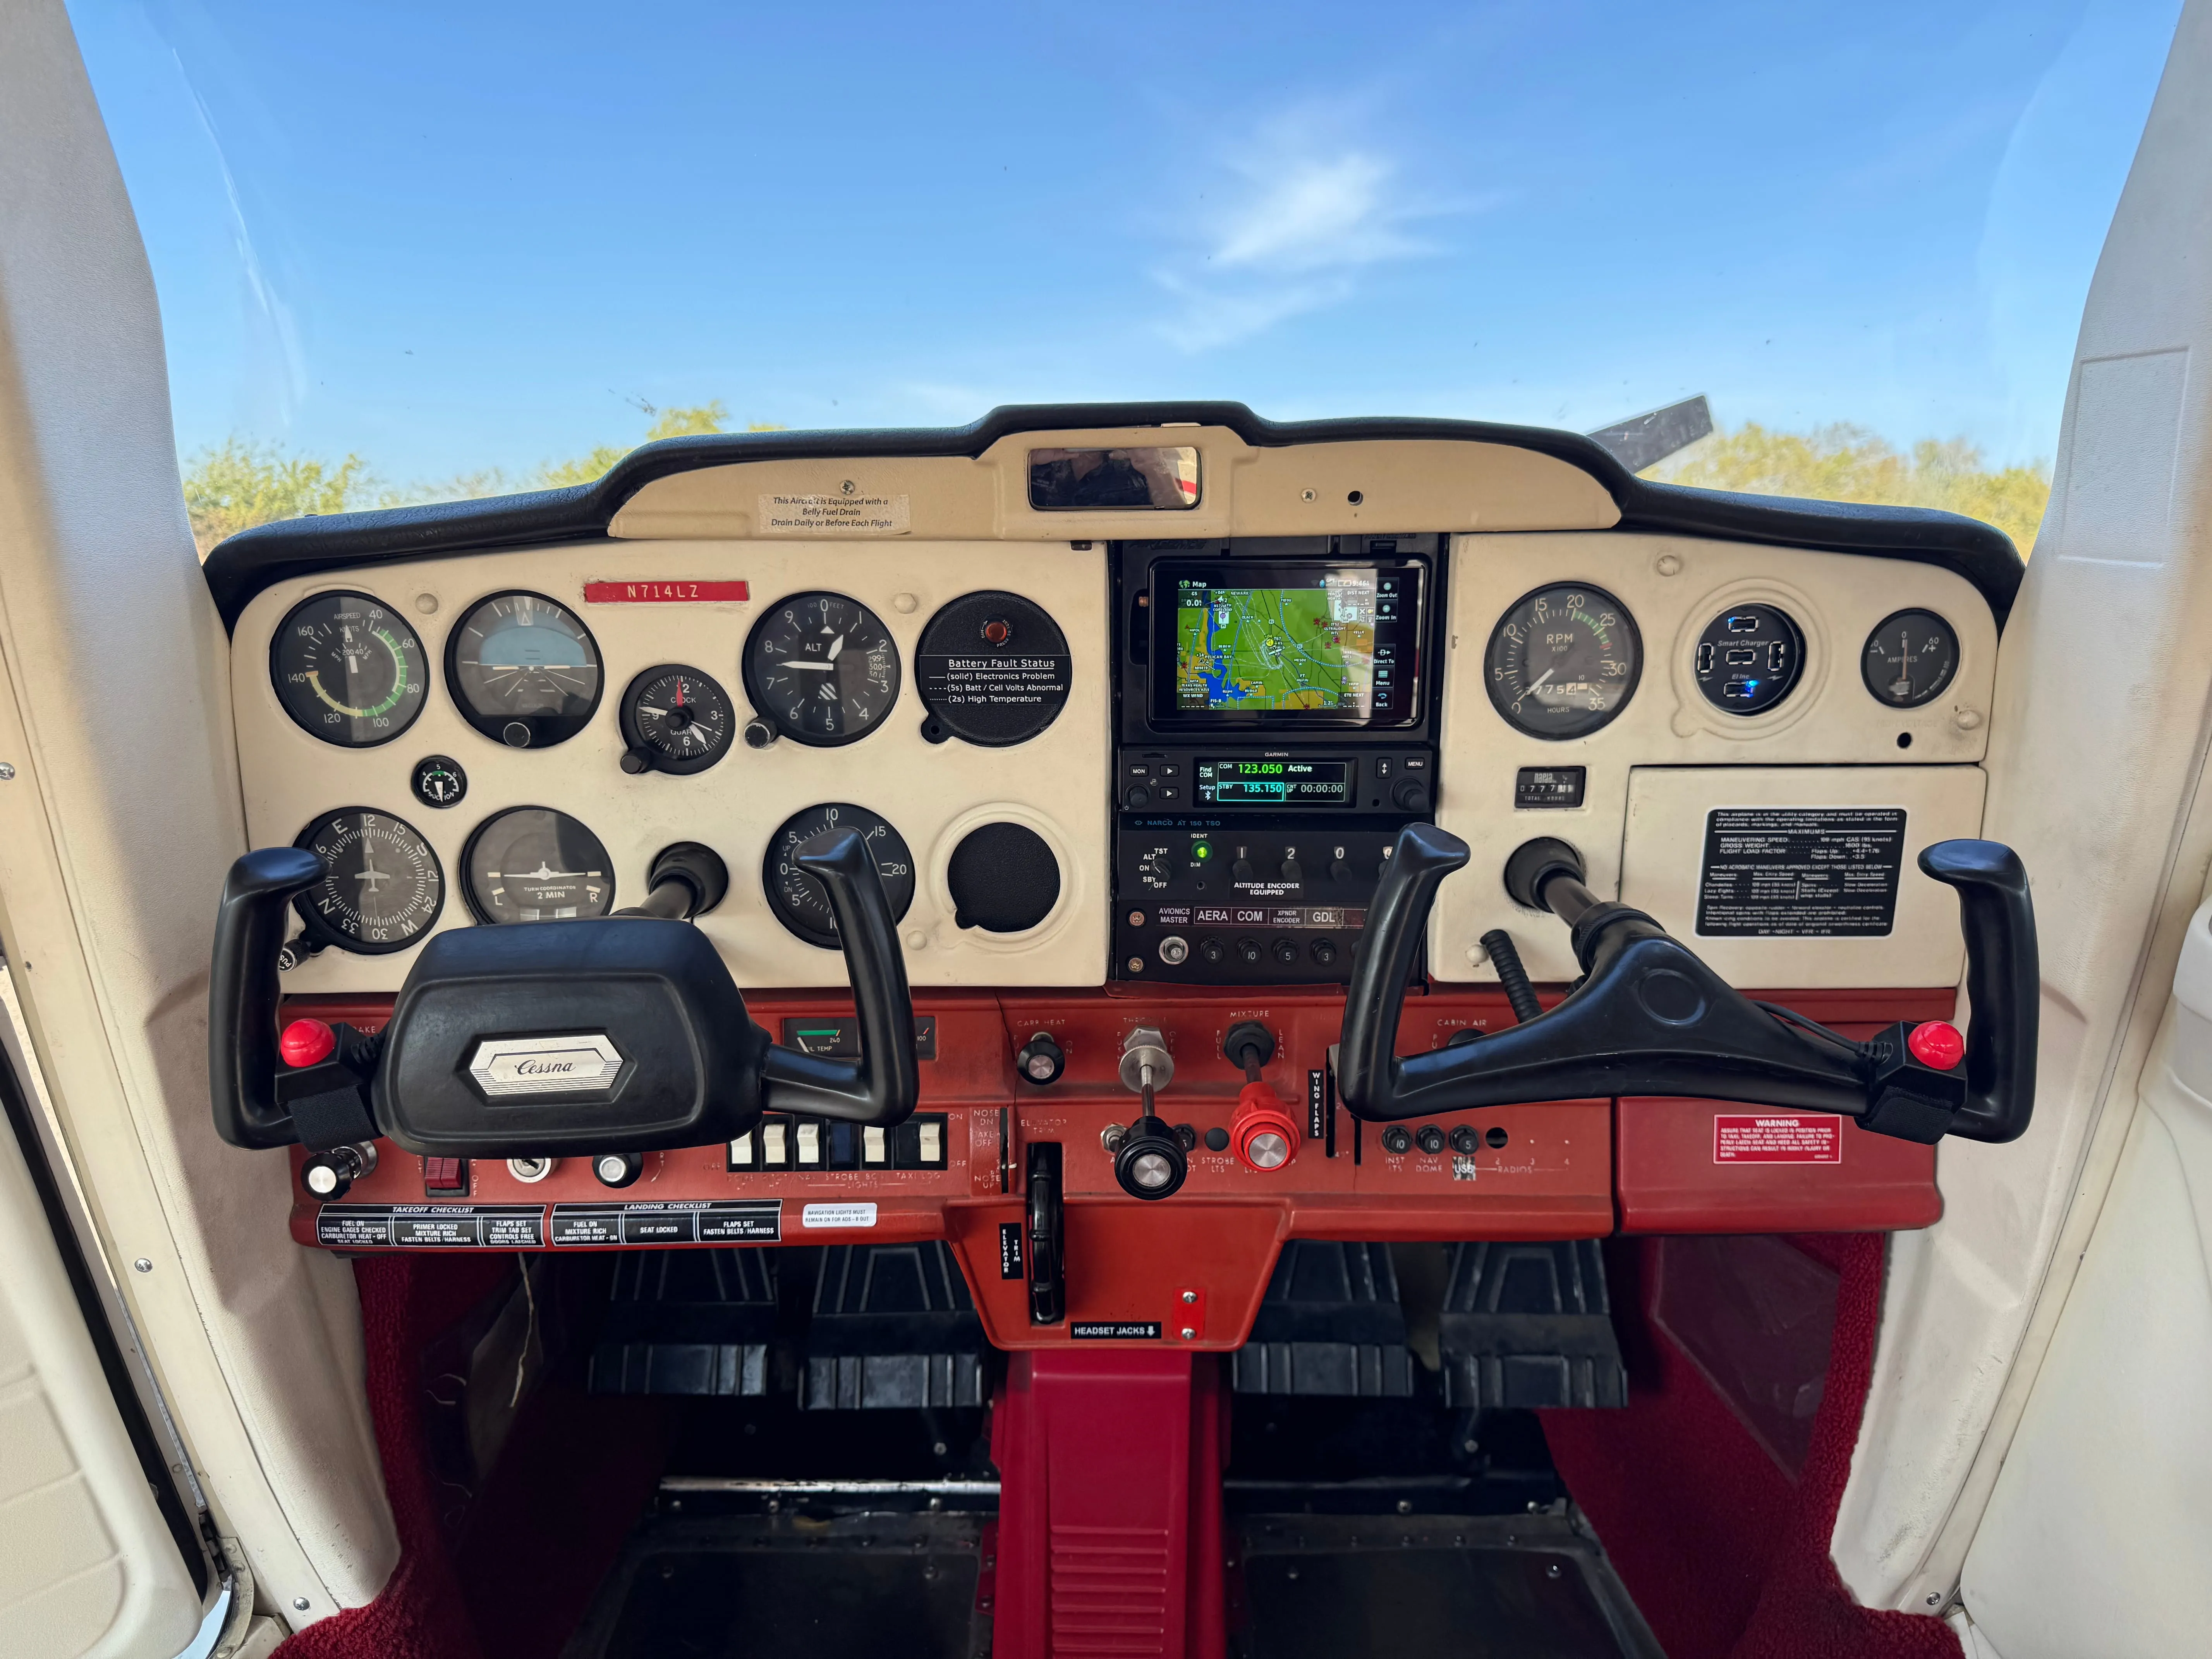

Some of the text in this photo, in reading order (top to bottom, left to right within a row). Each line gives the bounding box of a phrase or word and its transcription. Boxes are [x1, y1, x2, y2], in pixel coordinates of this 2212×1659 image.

[828, 498, 864, 506] Equipped
[803, 508, 821, 517] Belly
[795, 519, 814, 528] Daily
[871, 520, 892, 528] Flight
[628, 585, 698, 598] N714LZ
[1535, 598, 1547, 611] 15
[1567, 595, 1584, 608] 20
[369, 610, 382, 619] 40
[1600, 613, 1615, 626] 25
[298, 626, 313, 636] 160
[402, 639, 414, 648] 60
[1547, 634, 1572, 644] RPM
[992, 659, 1017, 667] Fault
[288, 673, 305, 683] 140
[407, 684, 419, 693] 80
[324, 713, 340, 723] 120
[373, 718, 389, 727] 100
[1239, 764, 1282, 773] 123.050
[1244, 784, 1281, 792] 135.150
[827, 809, 838, 820] 10
[364, 815, 375, 826] 12
[875, 826, 886, 836] 15
[892, 864, 906, 874] 20
[1198, 911, 1228, 921] AERA
[1238, 911, 1262, 921] COM
[1313, 912, 1335, 922] GDL
[515, 1060, 575, 1075] Cessna
